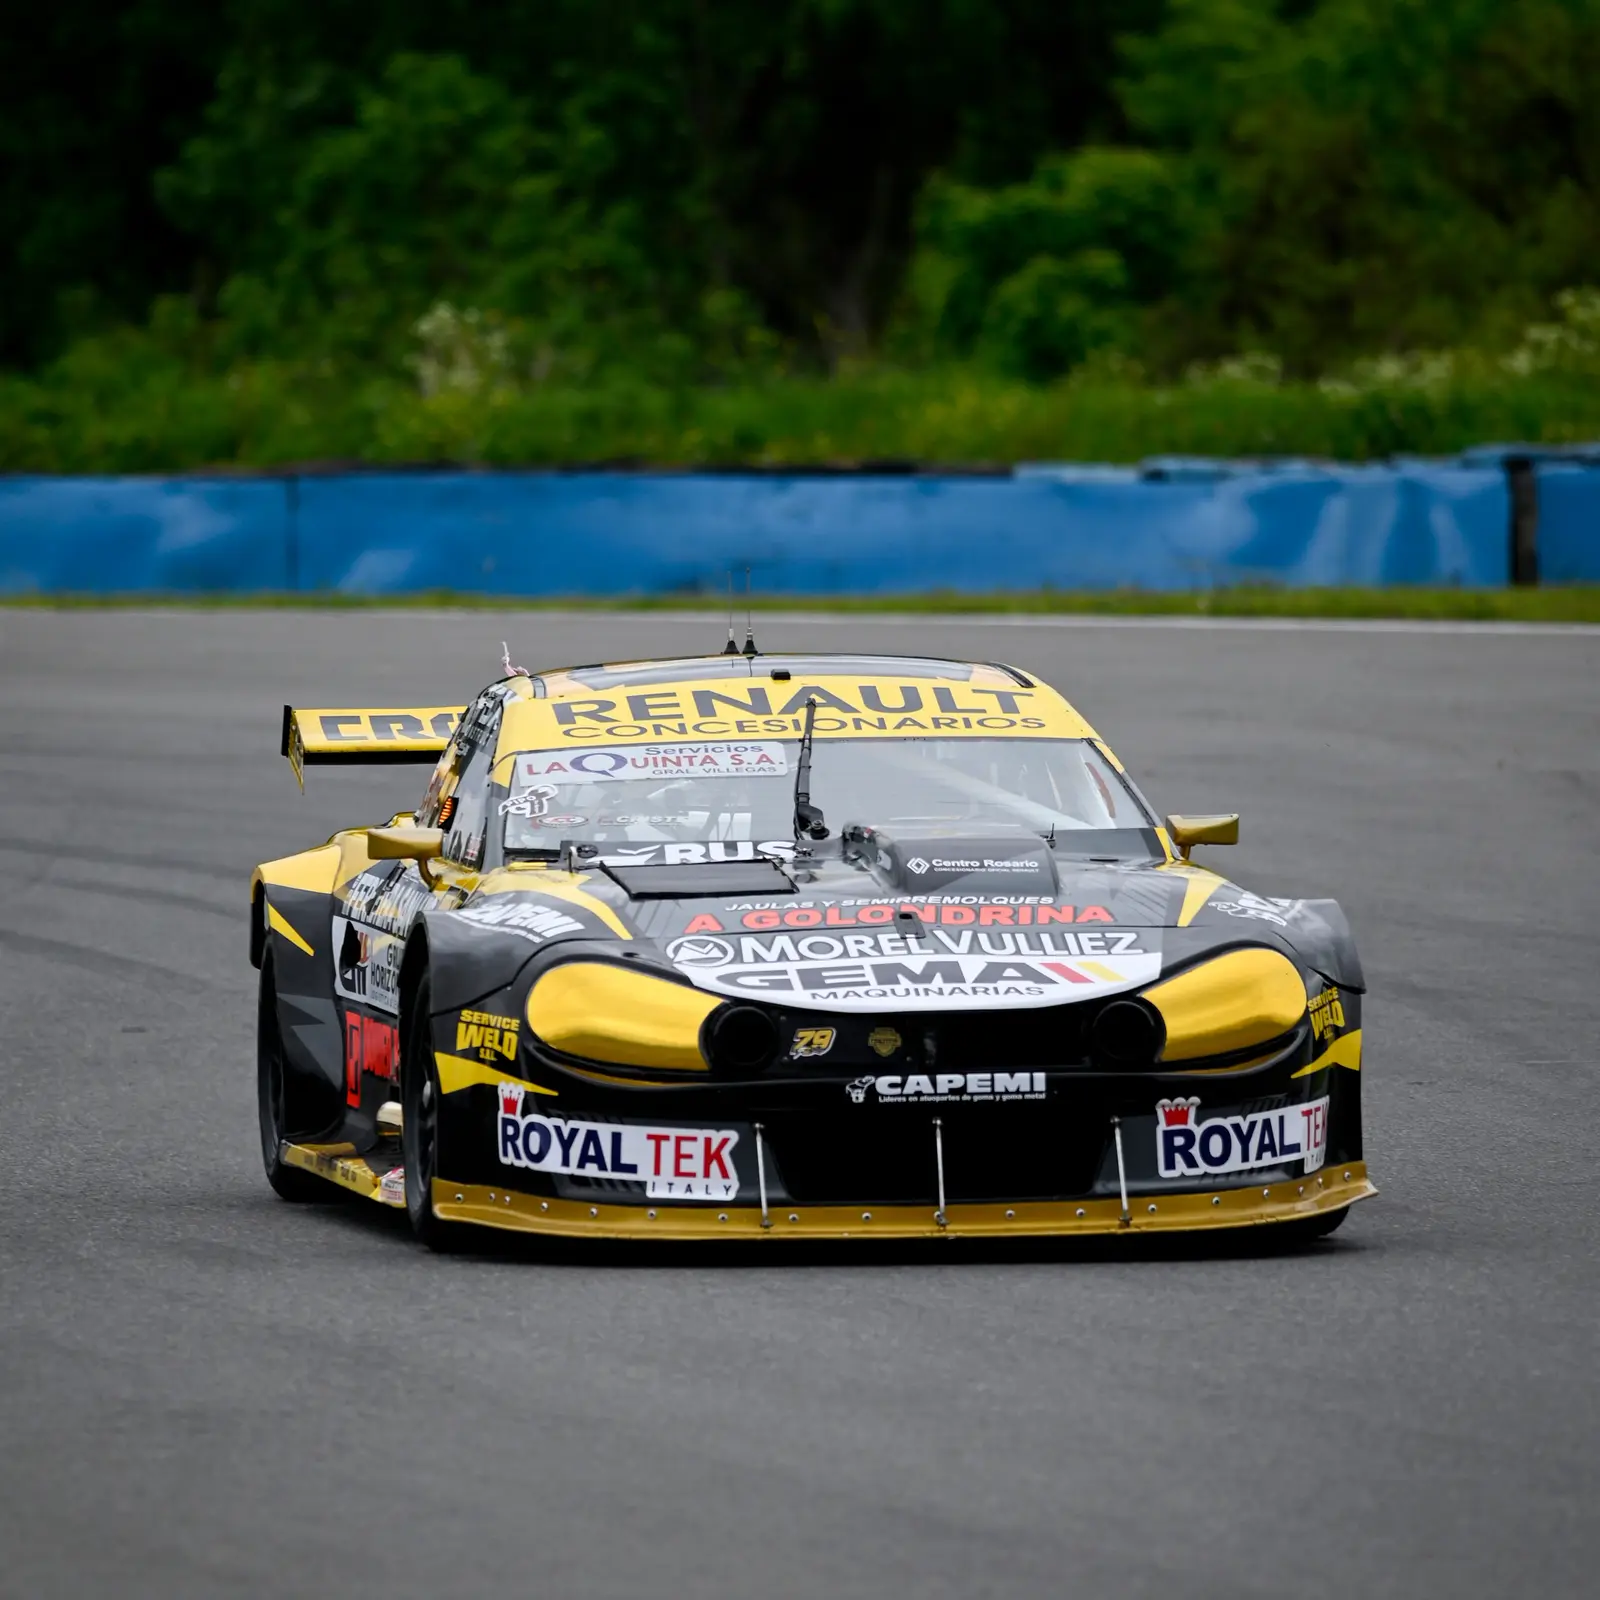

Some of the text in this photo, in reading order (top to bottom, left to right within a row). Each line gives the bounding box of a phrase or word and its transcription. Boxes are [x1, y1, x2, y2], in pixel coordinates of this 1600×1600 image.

[552, 685, 1034, 725] RENAULT
[562, 717, 1046, 738] CONCESIONARIOS
[645, 744, 764, 756] Servicios
[730, 753, 784, 766] S.A.
[702, 766, 777, 774] VILLEGAS
[664, 841, 797, 864] RUS
[931, 859, 1039, 868] Centro Rosario
[725, 901, 813, 910] JAULAS
[841, 896, 1054, 905] SEMIRREMOLQUES
[742, 904, 1115, 930] GOLONDRINA
[740, 930, 1144, 963] MOREL VULLIEZ
[715, 961, 1060, 991] GEMA
[810, 986, 1045, 1000] MAQUINARIAS
[460, 1009, 520, 1031] SERVICE
[1310, 1000, 1345, 1041] WELD
[456, 1022, 518, 1061] WELD
[793, 1029, 833, 1050] 79
[875, 1072, 1046, 1095] CAPEMI
[501, 1117, 731, 1179] ROYAL TEK
[1163, 1115, 1300, 1172] ROYAL
[650, 1181, 732, 1196] ITALY
